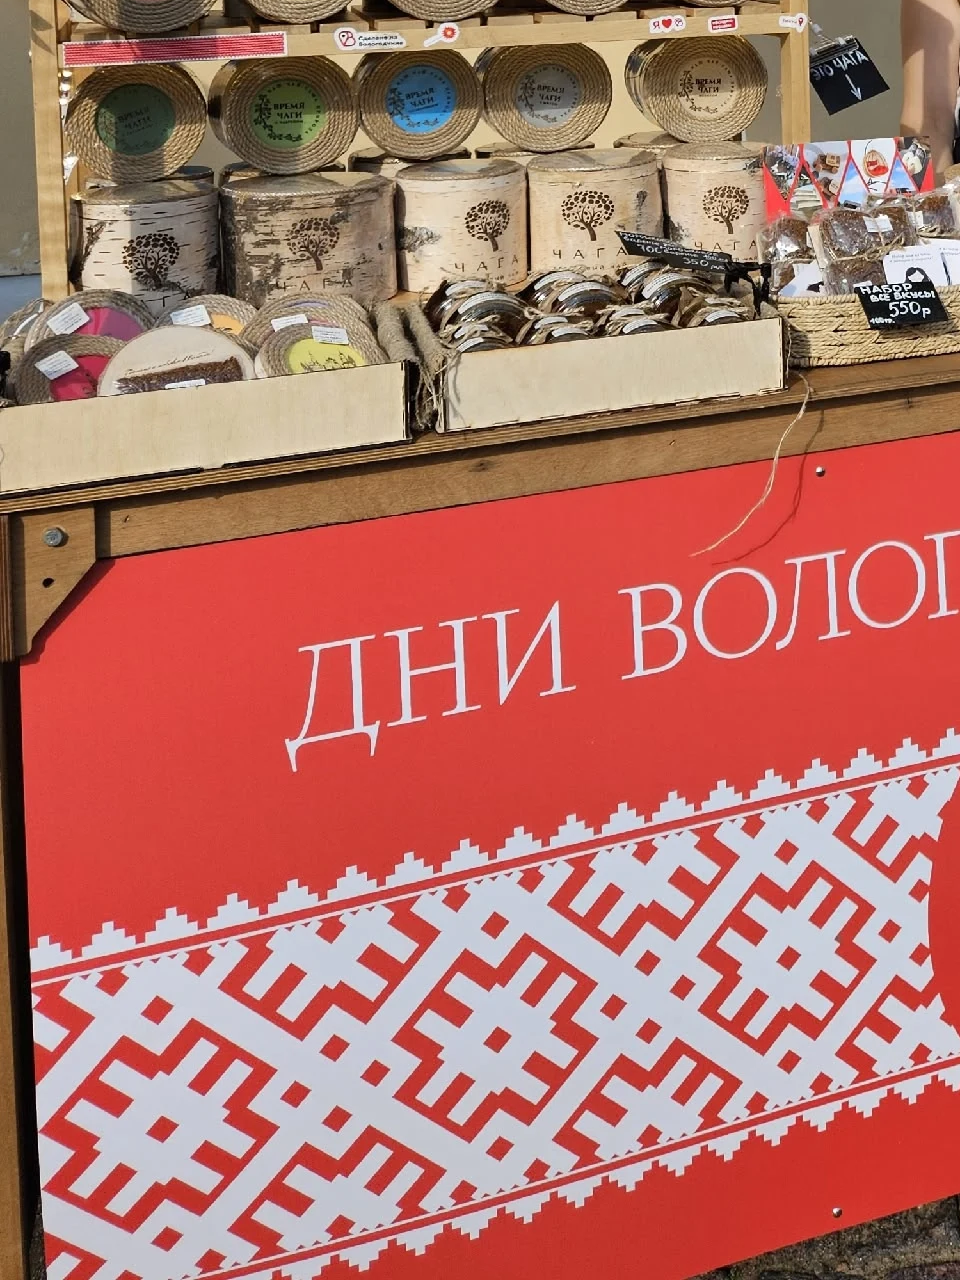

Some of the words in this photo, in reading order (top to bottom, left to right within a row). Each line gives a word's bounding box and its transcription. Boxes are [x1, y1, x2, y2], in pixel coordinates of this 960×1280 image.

[833, 50, 870, 72] ЧАГА
[695, 78, 722, 86] ВРЕМЯ
[404, 87, 435, 100] ВРЕМЯ
[536, 84, 565, 94] ВРЕМЯ
[697, 86, 720, 94] ЧАГИ
[538, 93, 562, 102] ЧАГИ
[273, 102, 306, 111] ВРЕМЯ
[276, 111, 303, 120] ЧАГИ
[694, 239, 758, 251] ЧАГА
[552, 246, 629, 260] ЧАГА
[454, 254, 520, 273] ЧАГА
[859, 283, 913, 295] НАБОР
[869, 294, 891, 303] ВСЕ
[894, 290, 936, 301] ВКУСЫ
[888, 301, 921, 318] 550
[285, 600, 577, 772] ДНИ
